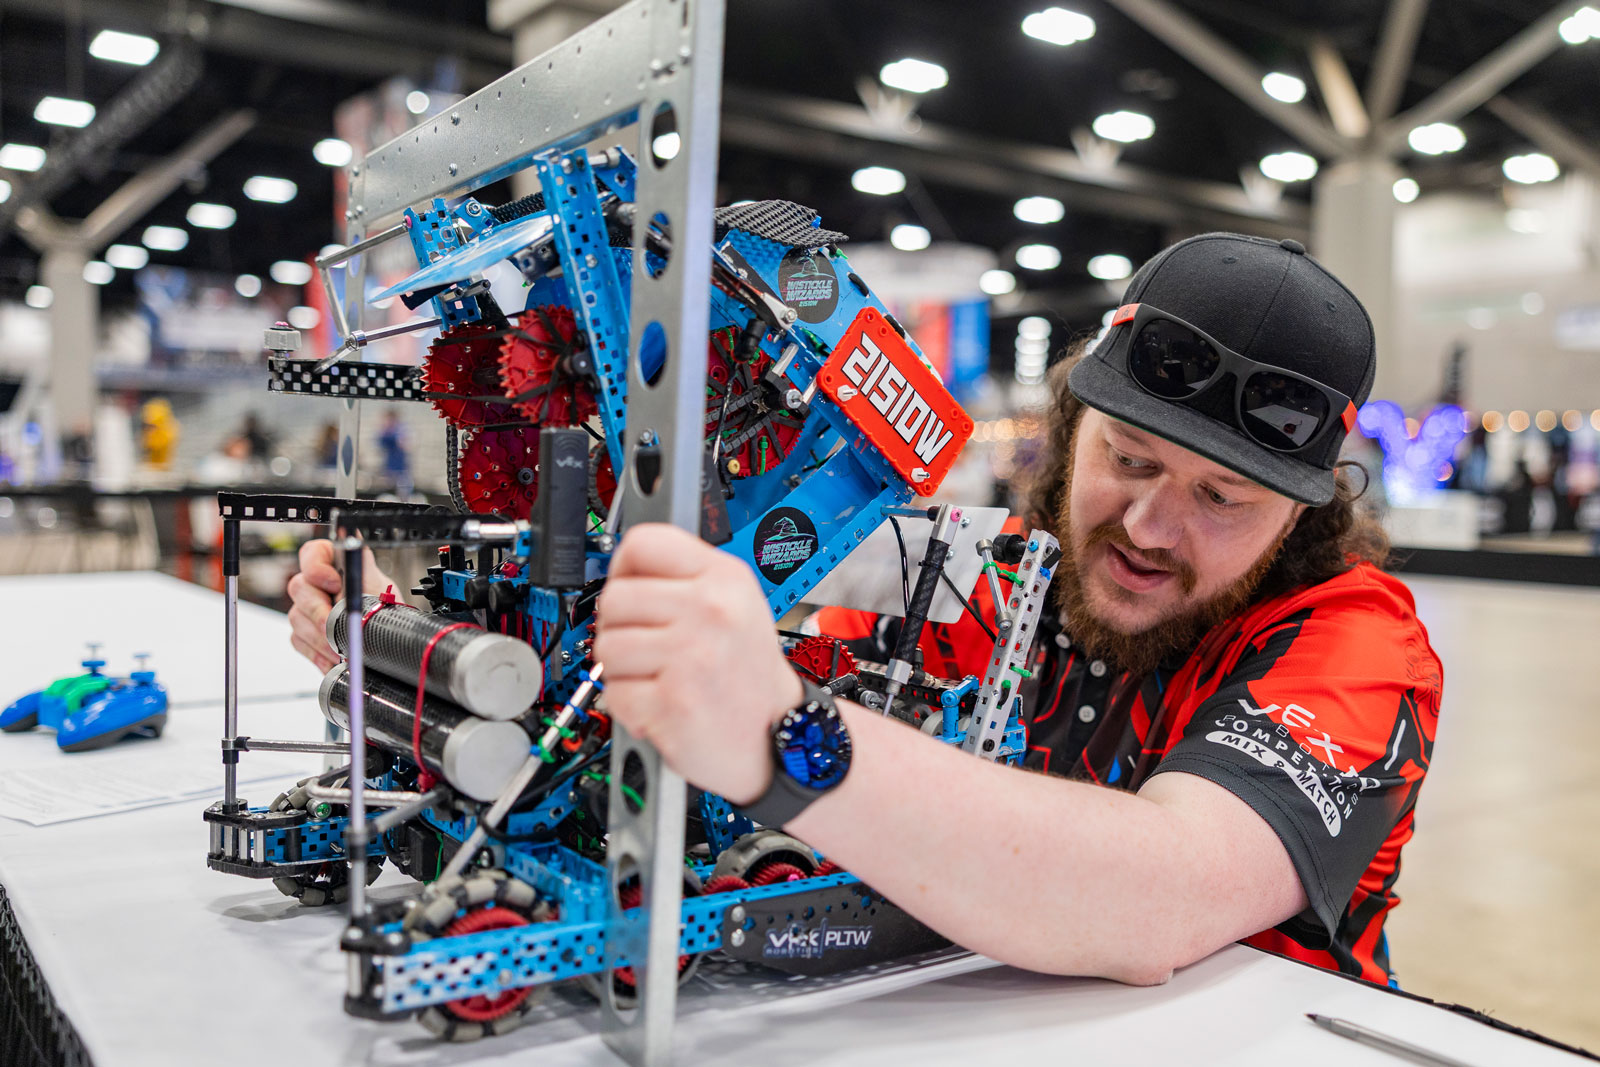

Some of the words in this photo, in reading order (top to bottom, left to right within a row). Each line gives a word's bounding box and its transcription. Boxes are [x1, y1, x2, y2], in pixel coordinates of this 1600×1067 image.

[785, 289, 833, 302] WIZARDS
[555, 456, 584, 469] VEX
[760, 548, 811, 567] WIZARDS
[1237, 699, 1345, 769] VEX
[1221, 734, 1267, 759] MIX
[1296, 770, 1337, 826] MATCH
[824, 930, 872, 947] PLTW
